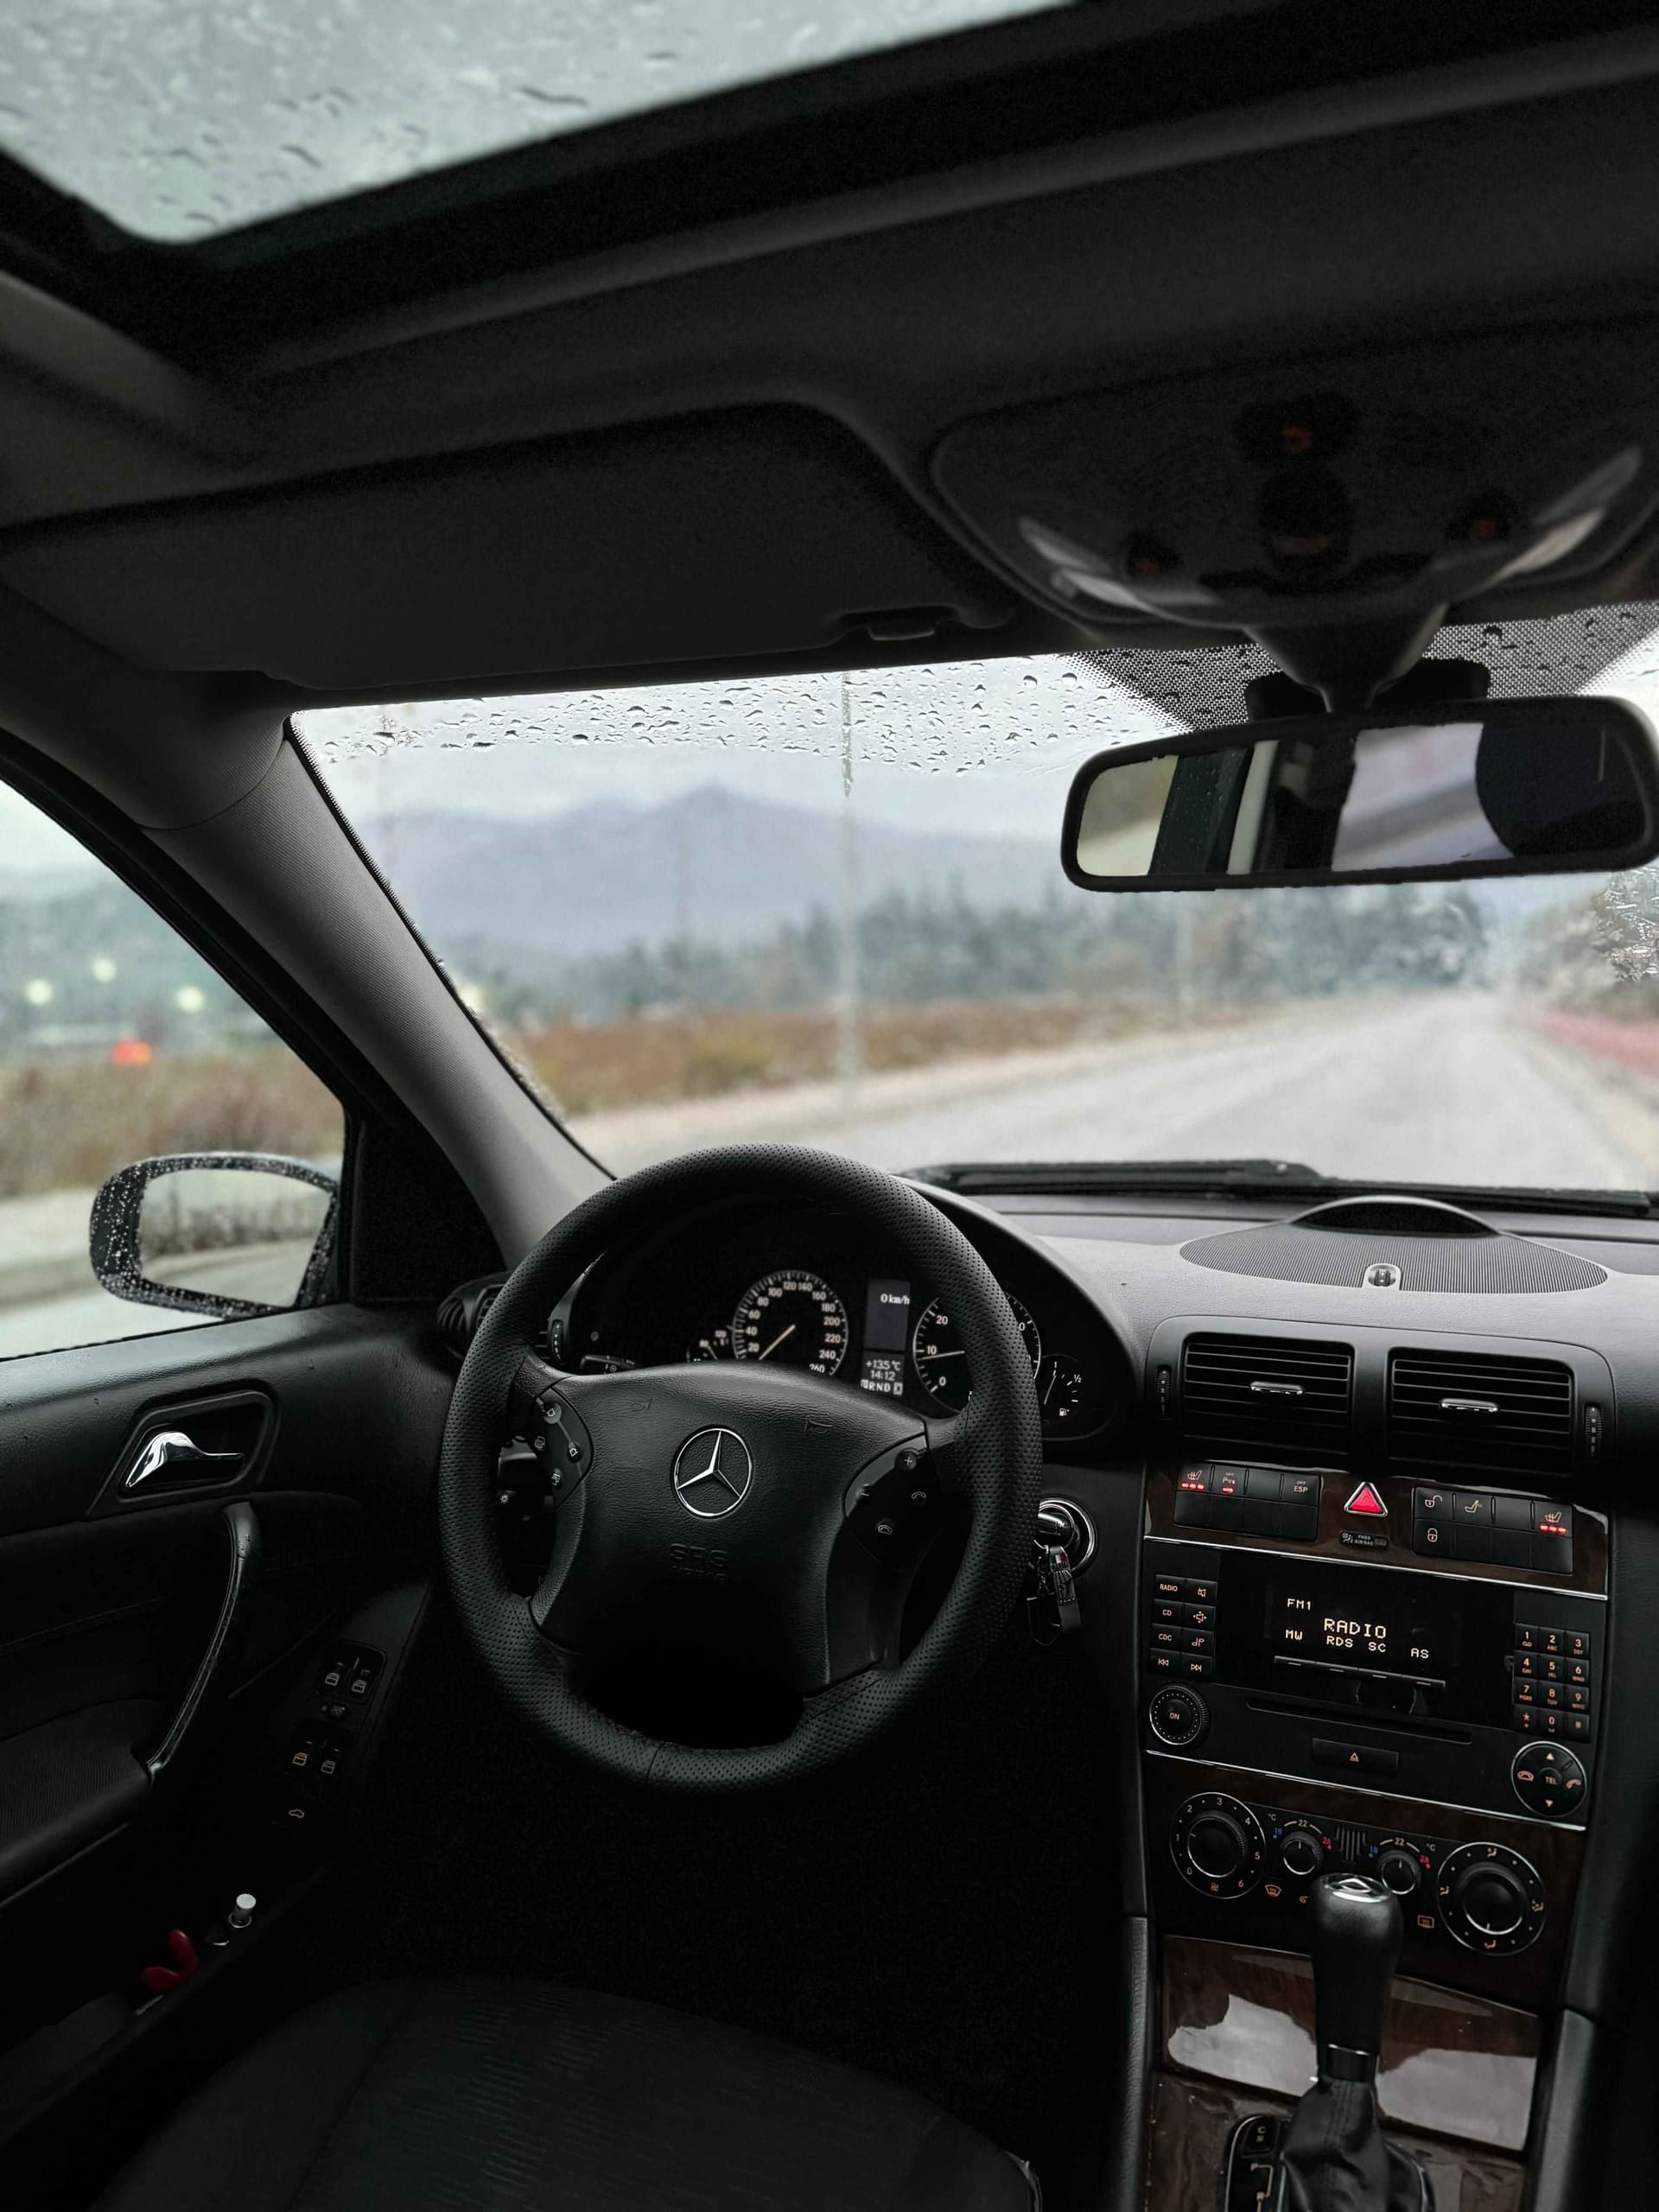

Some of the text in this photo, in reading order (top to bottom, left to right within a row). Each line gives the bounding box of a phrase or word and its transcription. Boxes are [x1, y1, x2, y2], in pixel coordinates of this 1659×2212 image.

[783, 1281, 798, 1291] 120
[798, 1281, 813, 1292] 140
[768, 1287, 783, 1297] 100
[812, 1291, 827, 1300] 160
[757, 1296, 769, 1307] 80
[822, 1302, 836, 1313] 180
[748, 1309, 760, 1320] 60
[823, 1316, 840, 1326] 200
[937, 1315, 949, 1325] 20
[746, 1326, 758, 1337] 40
[824, 1333, 841, 1344] 220
[747, 1343, 760, 1353] 20
[927, 1345, 938, 1356] 10
[819, 1350, 836, 1360] 240
[870, 1370, 896, 1381] 14:12
[939, 1376, 947, 1387] 0
[1294, 1484, 1309, 1494] ESP
[1160, 1583, 1179, 1592] RADIO
[1287, 1598, 1312, 1611] FM1
[1162, 1608, 1173, 1617] CD
[1324, 1618, 1387, 1639] RADIO
[1158, 1633, 1173, 1642] CDC
[1285, 1629, 1303, 1641] MW
[1549, 1634, 1556, 1643] 2
[1326, 1635, 1387, 1653] RDS SC
[1575, 1638, 1582, 1648] 3
[1410, 1648, 1429, 1659] AS
[1522, 1658, 1529, 1667] 4
[1548, 1662, 1556, 1671] 5
[1575, 1666, 1582, 1675] 6
[1523, 1684, 1530, 1694] 7
[1548, 1688, 1555, 1698] 8
[1575, 1693, 1581, 1701] 9
[1169, 1712, 1180, 1720] ON
[1548, 1716, 1555, 1725] 0
[1545, 1775, 1556, 1786] TEL
[1217, 1797, 1223, 1806] 3
[1186, 1804, 1193, 1813] 2
[1244, 1816, 1251, 1826] 4
[1395, 1838, 1404, 1847] 22
[1254, 1852, 1261, 1860] 5
[1186, 1866, 1193, 1876] 0
[1237, 1879, 1244, 1888] 6
